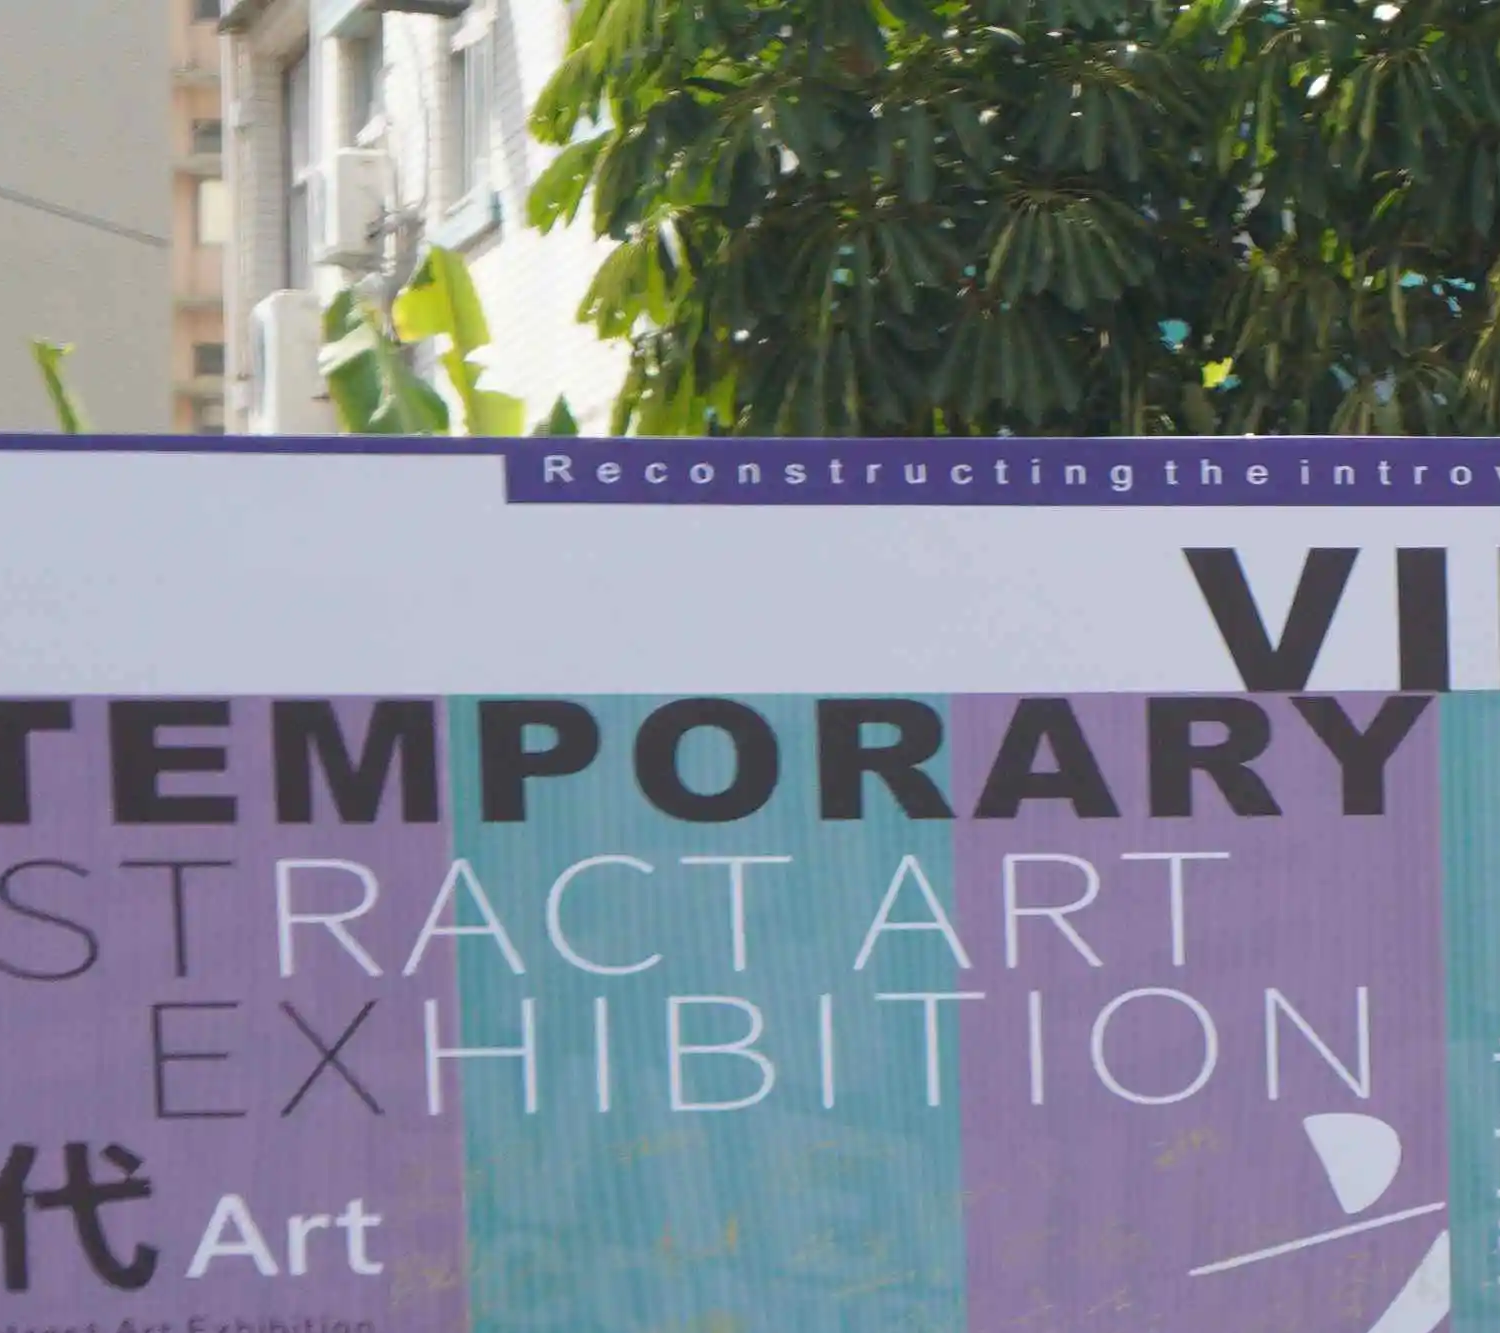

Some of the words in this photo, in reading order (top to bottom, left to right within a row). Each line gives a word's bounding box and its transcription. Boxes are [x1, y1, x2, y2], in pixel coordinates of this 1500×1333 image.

[853, 852, 1231, 971] ART
[152, 985, 1371, 1119] EXHIBITION
[185, 1194, 383, 1278] Art
